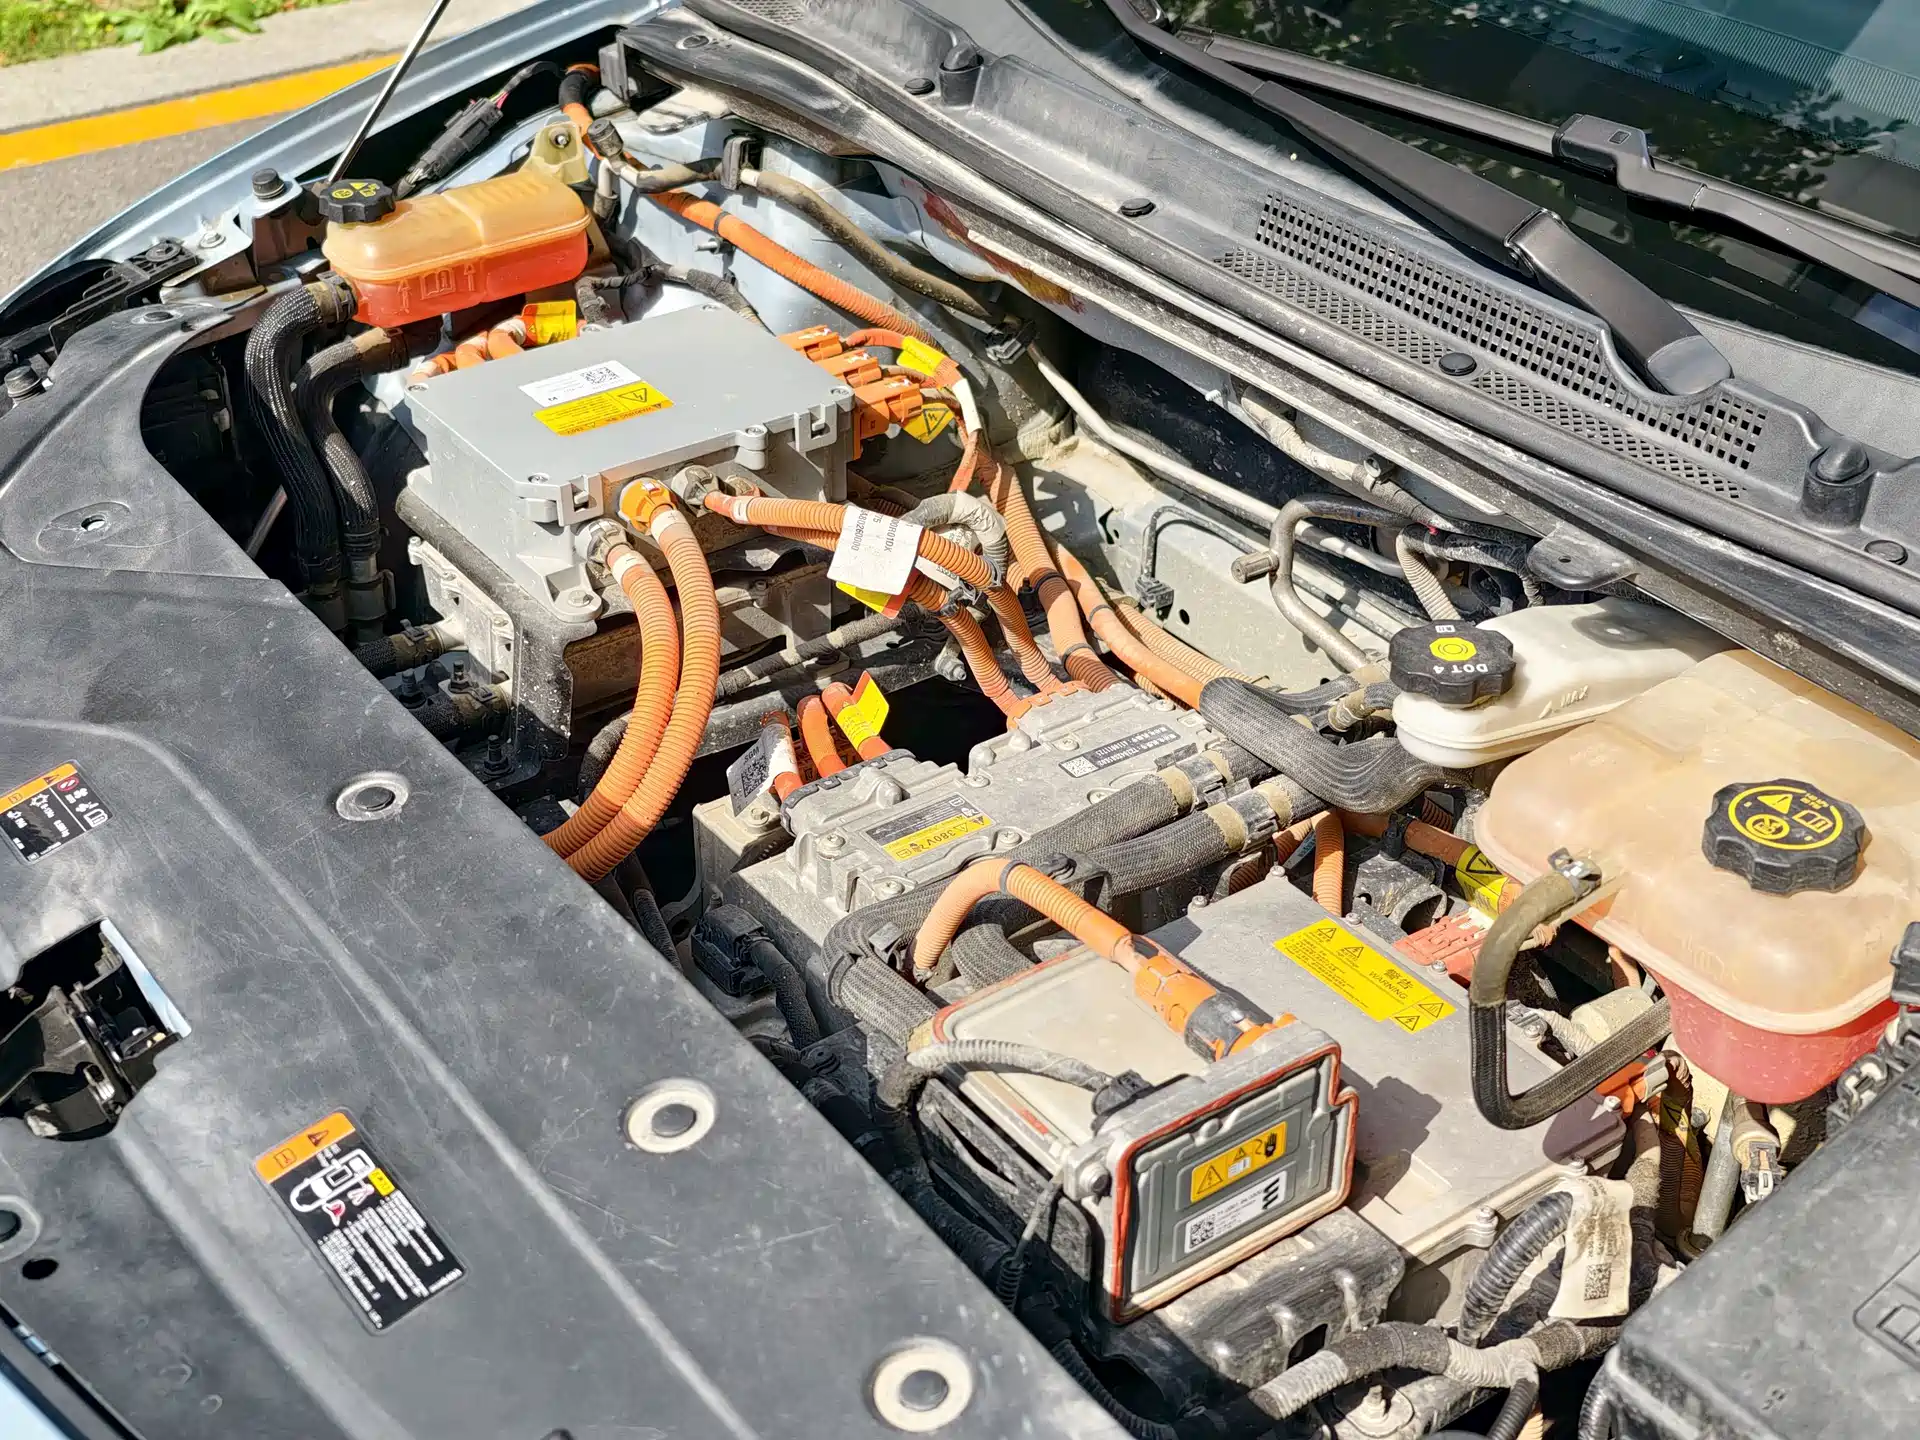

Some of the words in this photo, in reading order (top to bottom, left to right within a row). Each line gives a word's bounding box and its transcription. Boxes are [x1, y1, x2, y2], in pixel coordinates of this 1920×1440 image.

[1432, 665, 1445, 675] 4
[1451, 663, 1489, 674] DOT
[927, 829, 956, 846] 380V
[1369, 971, 1408, 999] WARNING
[1384, 969, 1414, 989] 警告
